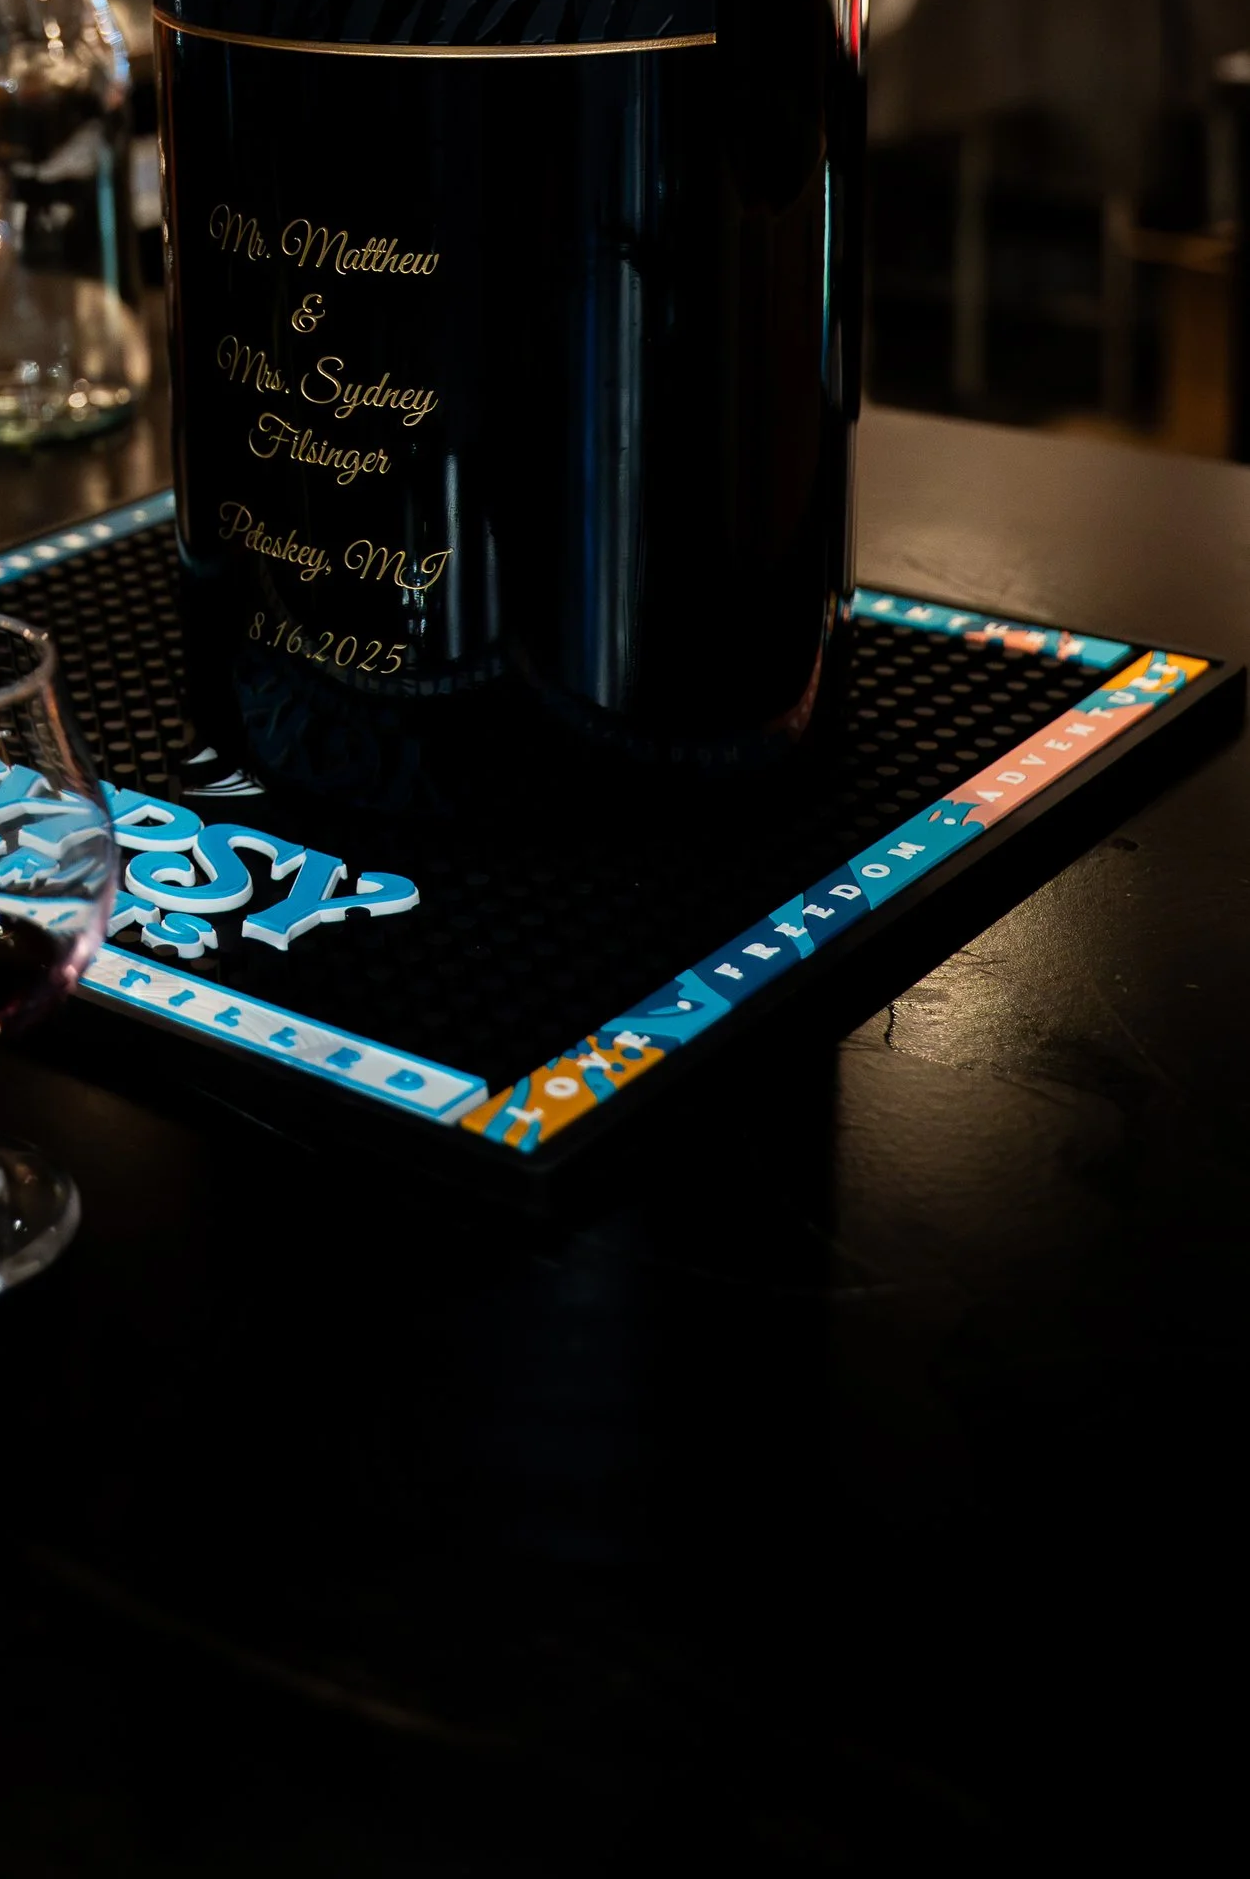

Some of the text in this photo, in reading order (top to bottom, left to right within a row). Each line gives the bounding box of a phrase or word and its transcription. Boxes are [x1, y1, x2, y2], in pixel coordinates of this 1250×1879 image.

[209, 203, 440, 275] Mr. Matthew
[291, 293, 326, 333] &
[217, 335, 438, 426] Mrs. Sydney
[249, 412, 391, 485] Filsinger
[219, 501, 332, 581] Petoskey,
[249, 612, 408, 674] 8.16.2025
[506, 663, 1179, 1124] LOVE FREEDOM ADVENTURE
